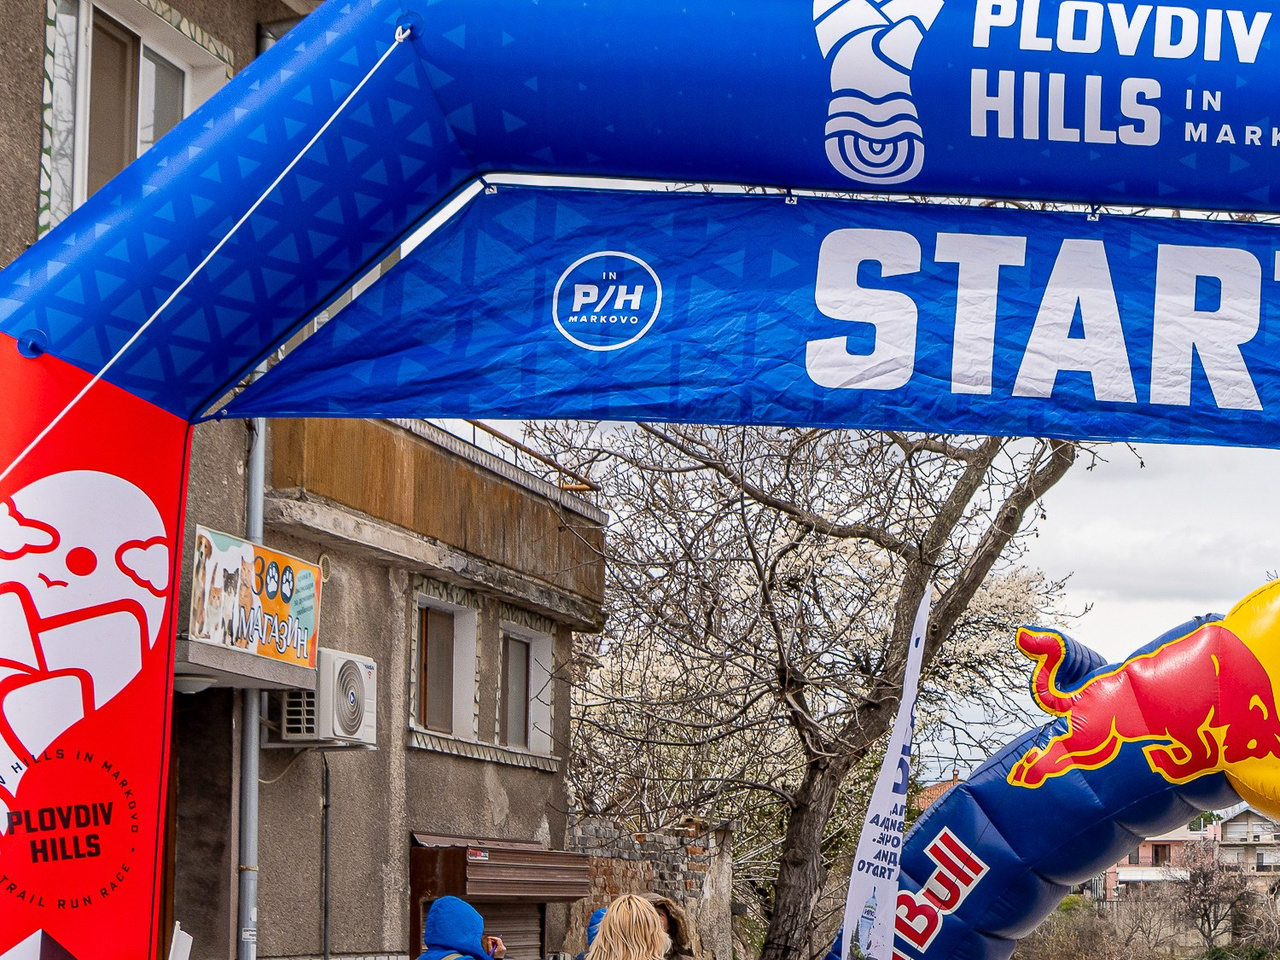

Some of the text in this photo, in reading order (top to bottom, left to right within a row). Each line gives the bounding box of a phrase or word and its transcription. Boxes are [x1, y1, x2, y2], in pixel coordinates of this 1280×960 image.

[972, 0, 1272, 63] PLOVDIV
[970, 69, 1162, 146] HILLS
[1185, 89, 1222, 112] IN
[602, 271, 617, 280] IN
[572, 283, 644, 313] P/H
[568, 315, 639, 324] MARKOVO
[238, 605, 308, 659] МАГАЗИН
[11, 749, 139, 833] HILLS IN MARKOVO
[6, 802, 113, 835] PLOVDIV
[30, 834, 101, 863] HILLS
[0, 864, 130, 909] TRAIL RUN RACE
[895, 830, 987, 950] Bull
